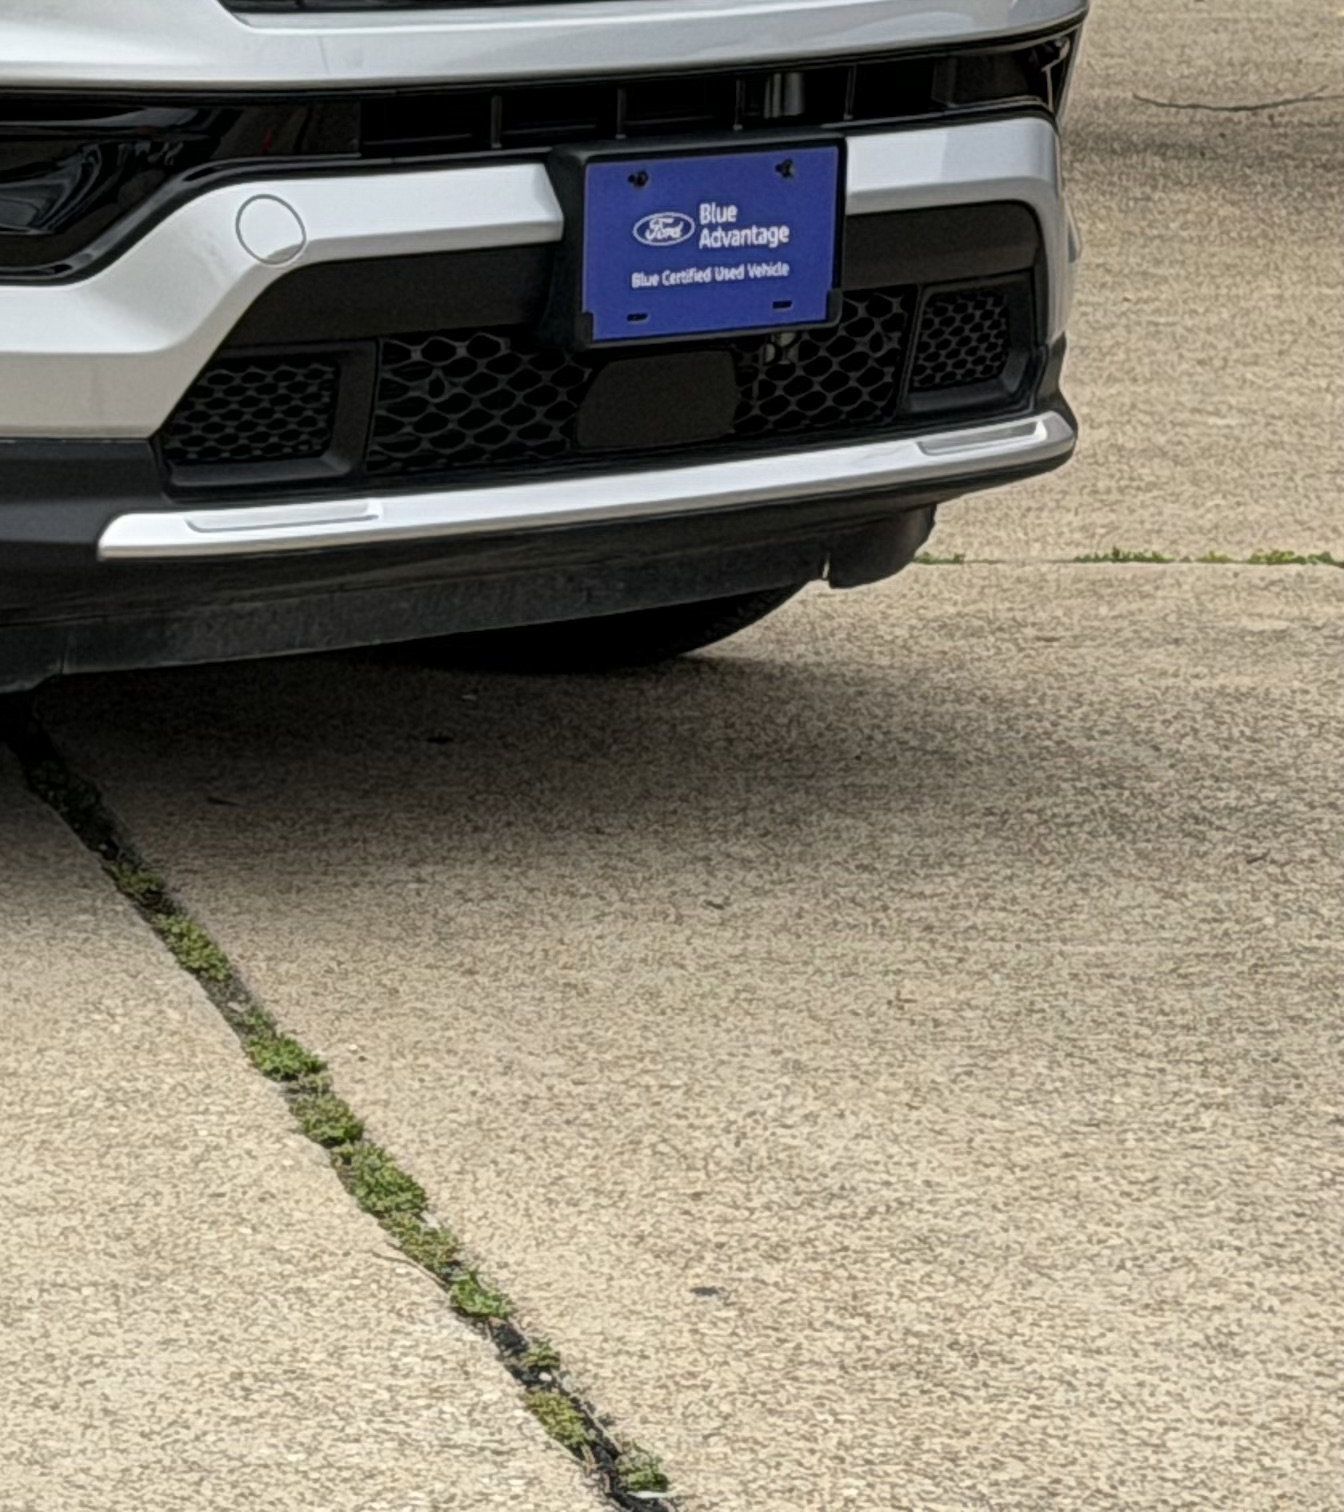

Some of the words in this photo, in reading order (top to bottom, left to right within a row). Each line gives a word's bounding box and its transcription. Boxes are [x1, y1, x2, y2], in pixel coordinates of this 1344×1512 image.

[698, 201, 738, 225] Blue
[698, 224, 790, 249] Advantage
[631, 271, 660, 288] Blue
[661, 266, 712, 286] Certified
[714, 263, 745, 281] Used
[747, 261, 790, 280] Vehicle
